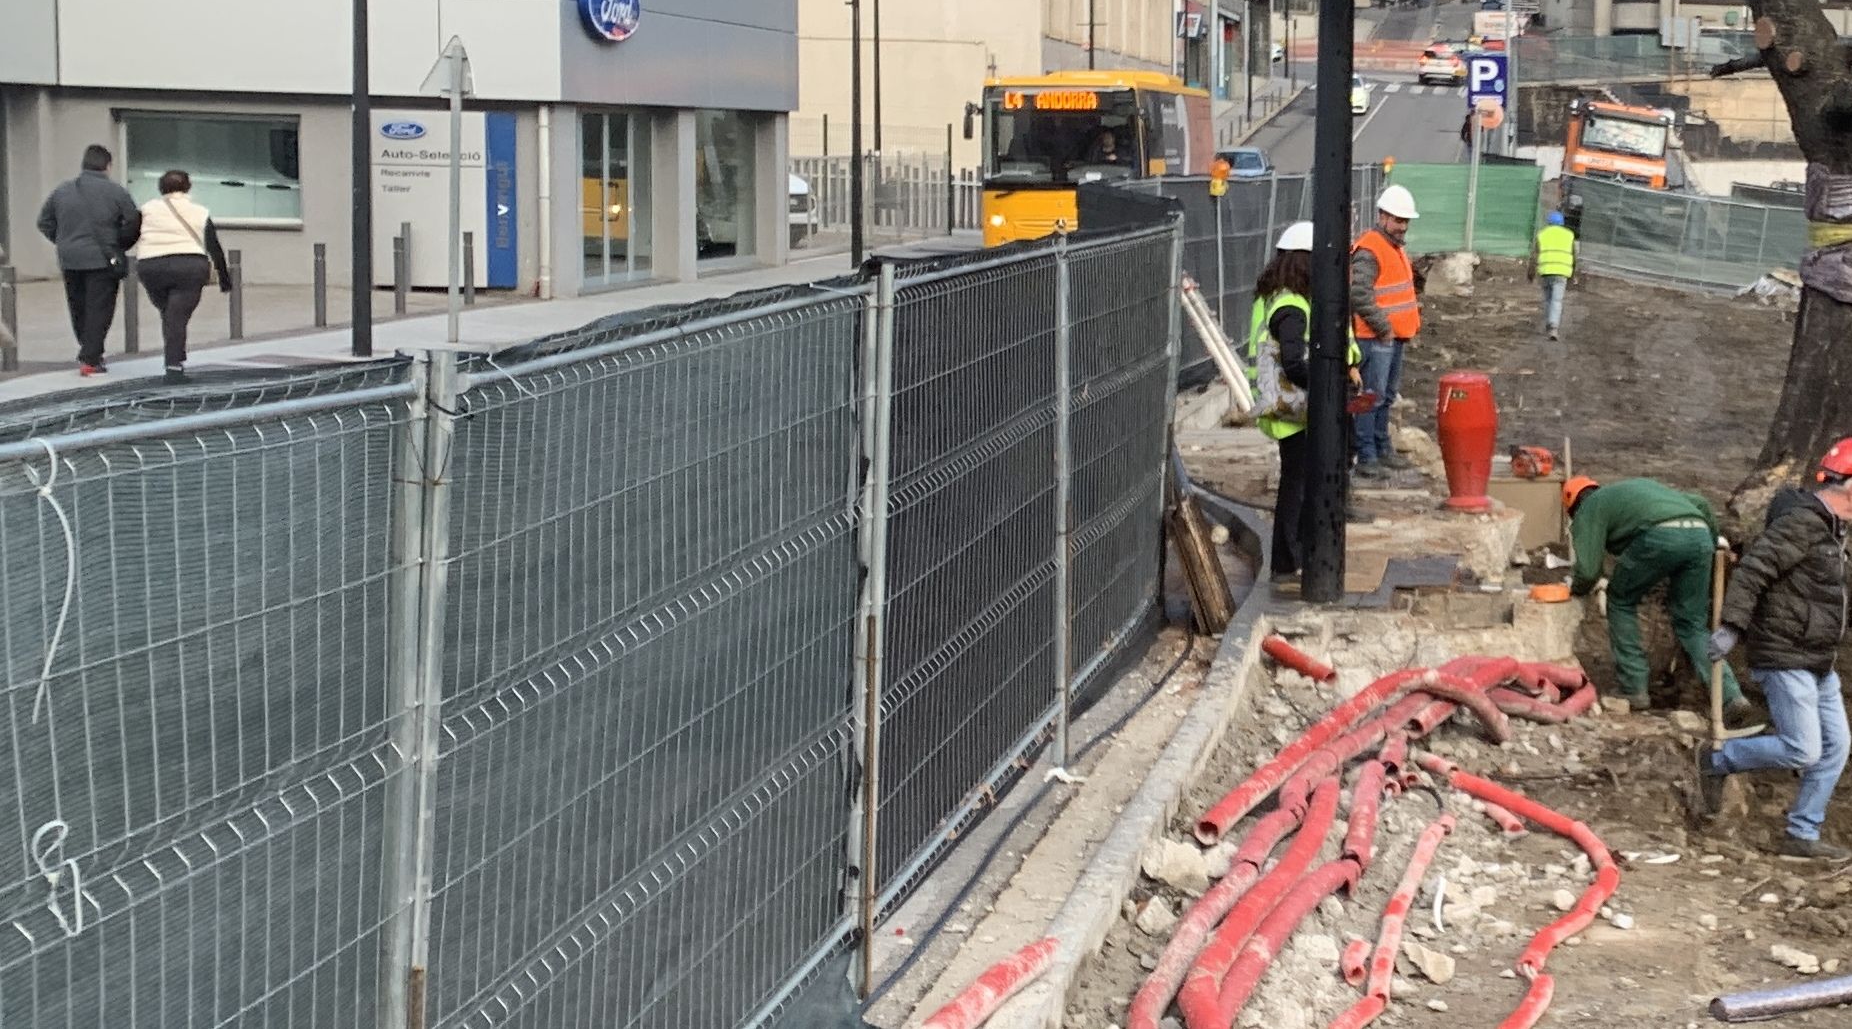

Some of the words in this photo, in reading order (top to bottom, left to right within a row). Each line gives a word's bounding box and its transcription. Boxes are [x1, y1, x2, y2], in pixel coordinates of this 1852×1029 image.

[1471, 59, 1499, 92] P
[1004, 90, 1025, 110] L4
[1036, 90, 1098, 110] ANDORRA
[381, 149, 481, 161] Auto-Seleció
[382, 185, 411, 193] Taller
